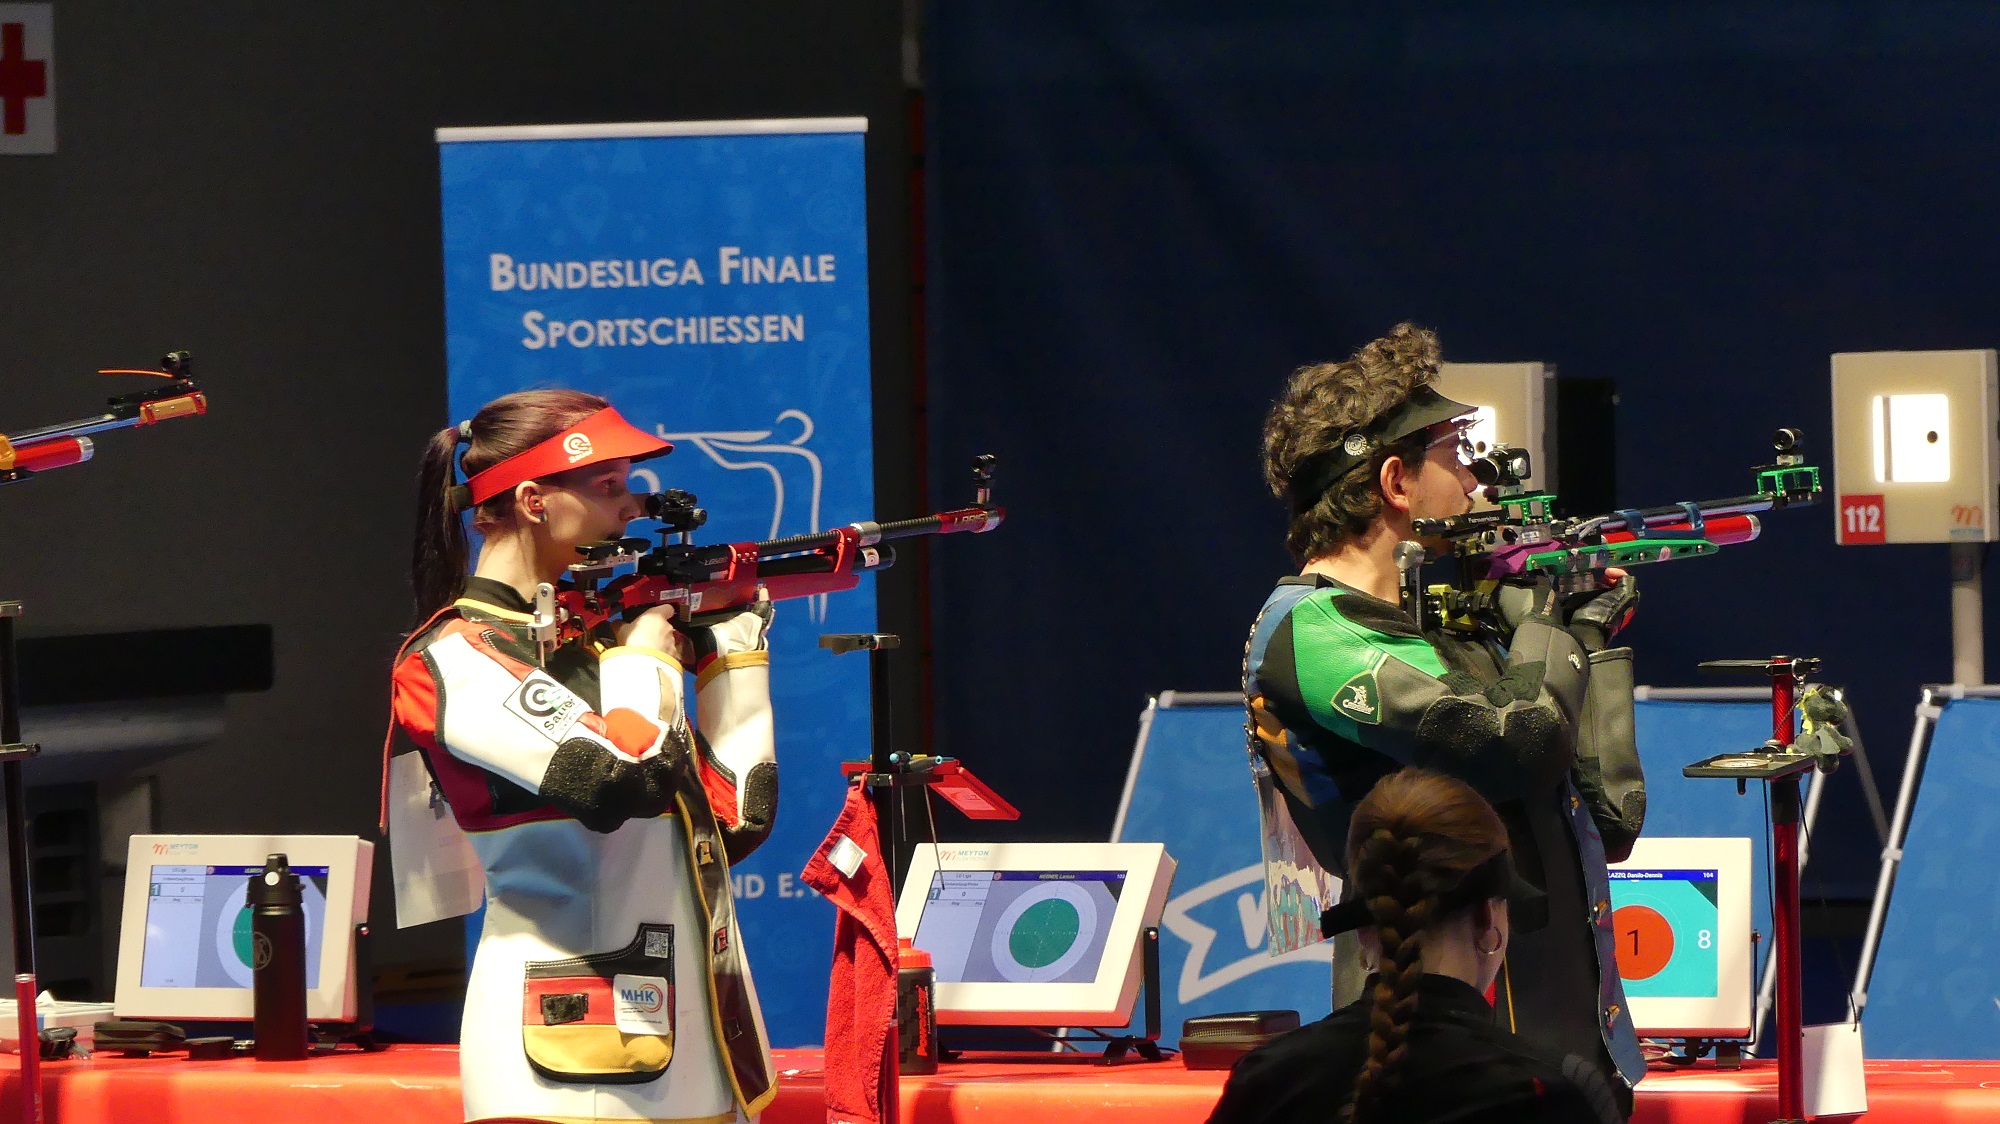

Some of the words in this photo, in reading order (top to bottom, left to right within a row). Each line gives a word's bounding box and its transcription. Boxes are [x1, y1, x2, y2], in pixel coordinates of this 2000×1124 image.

[1843, 504, 1881, 533] 112
[1626, 929, 1639, 956] 1
[1697, 929, 1712, 949] 8
[621, 988, 655, 1003] MHK
